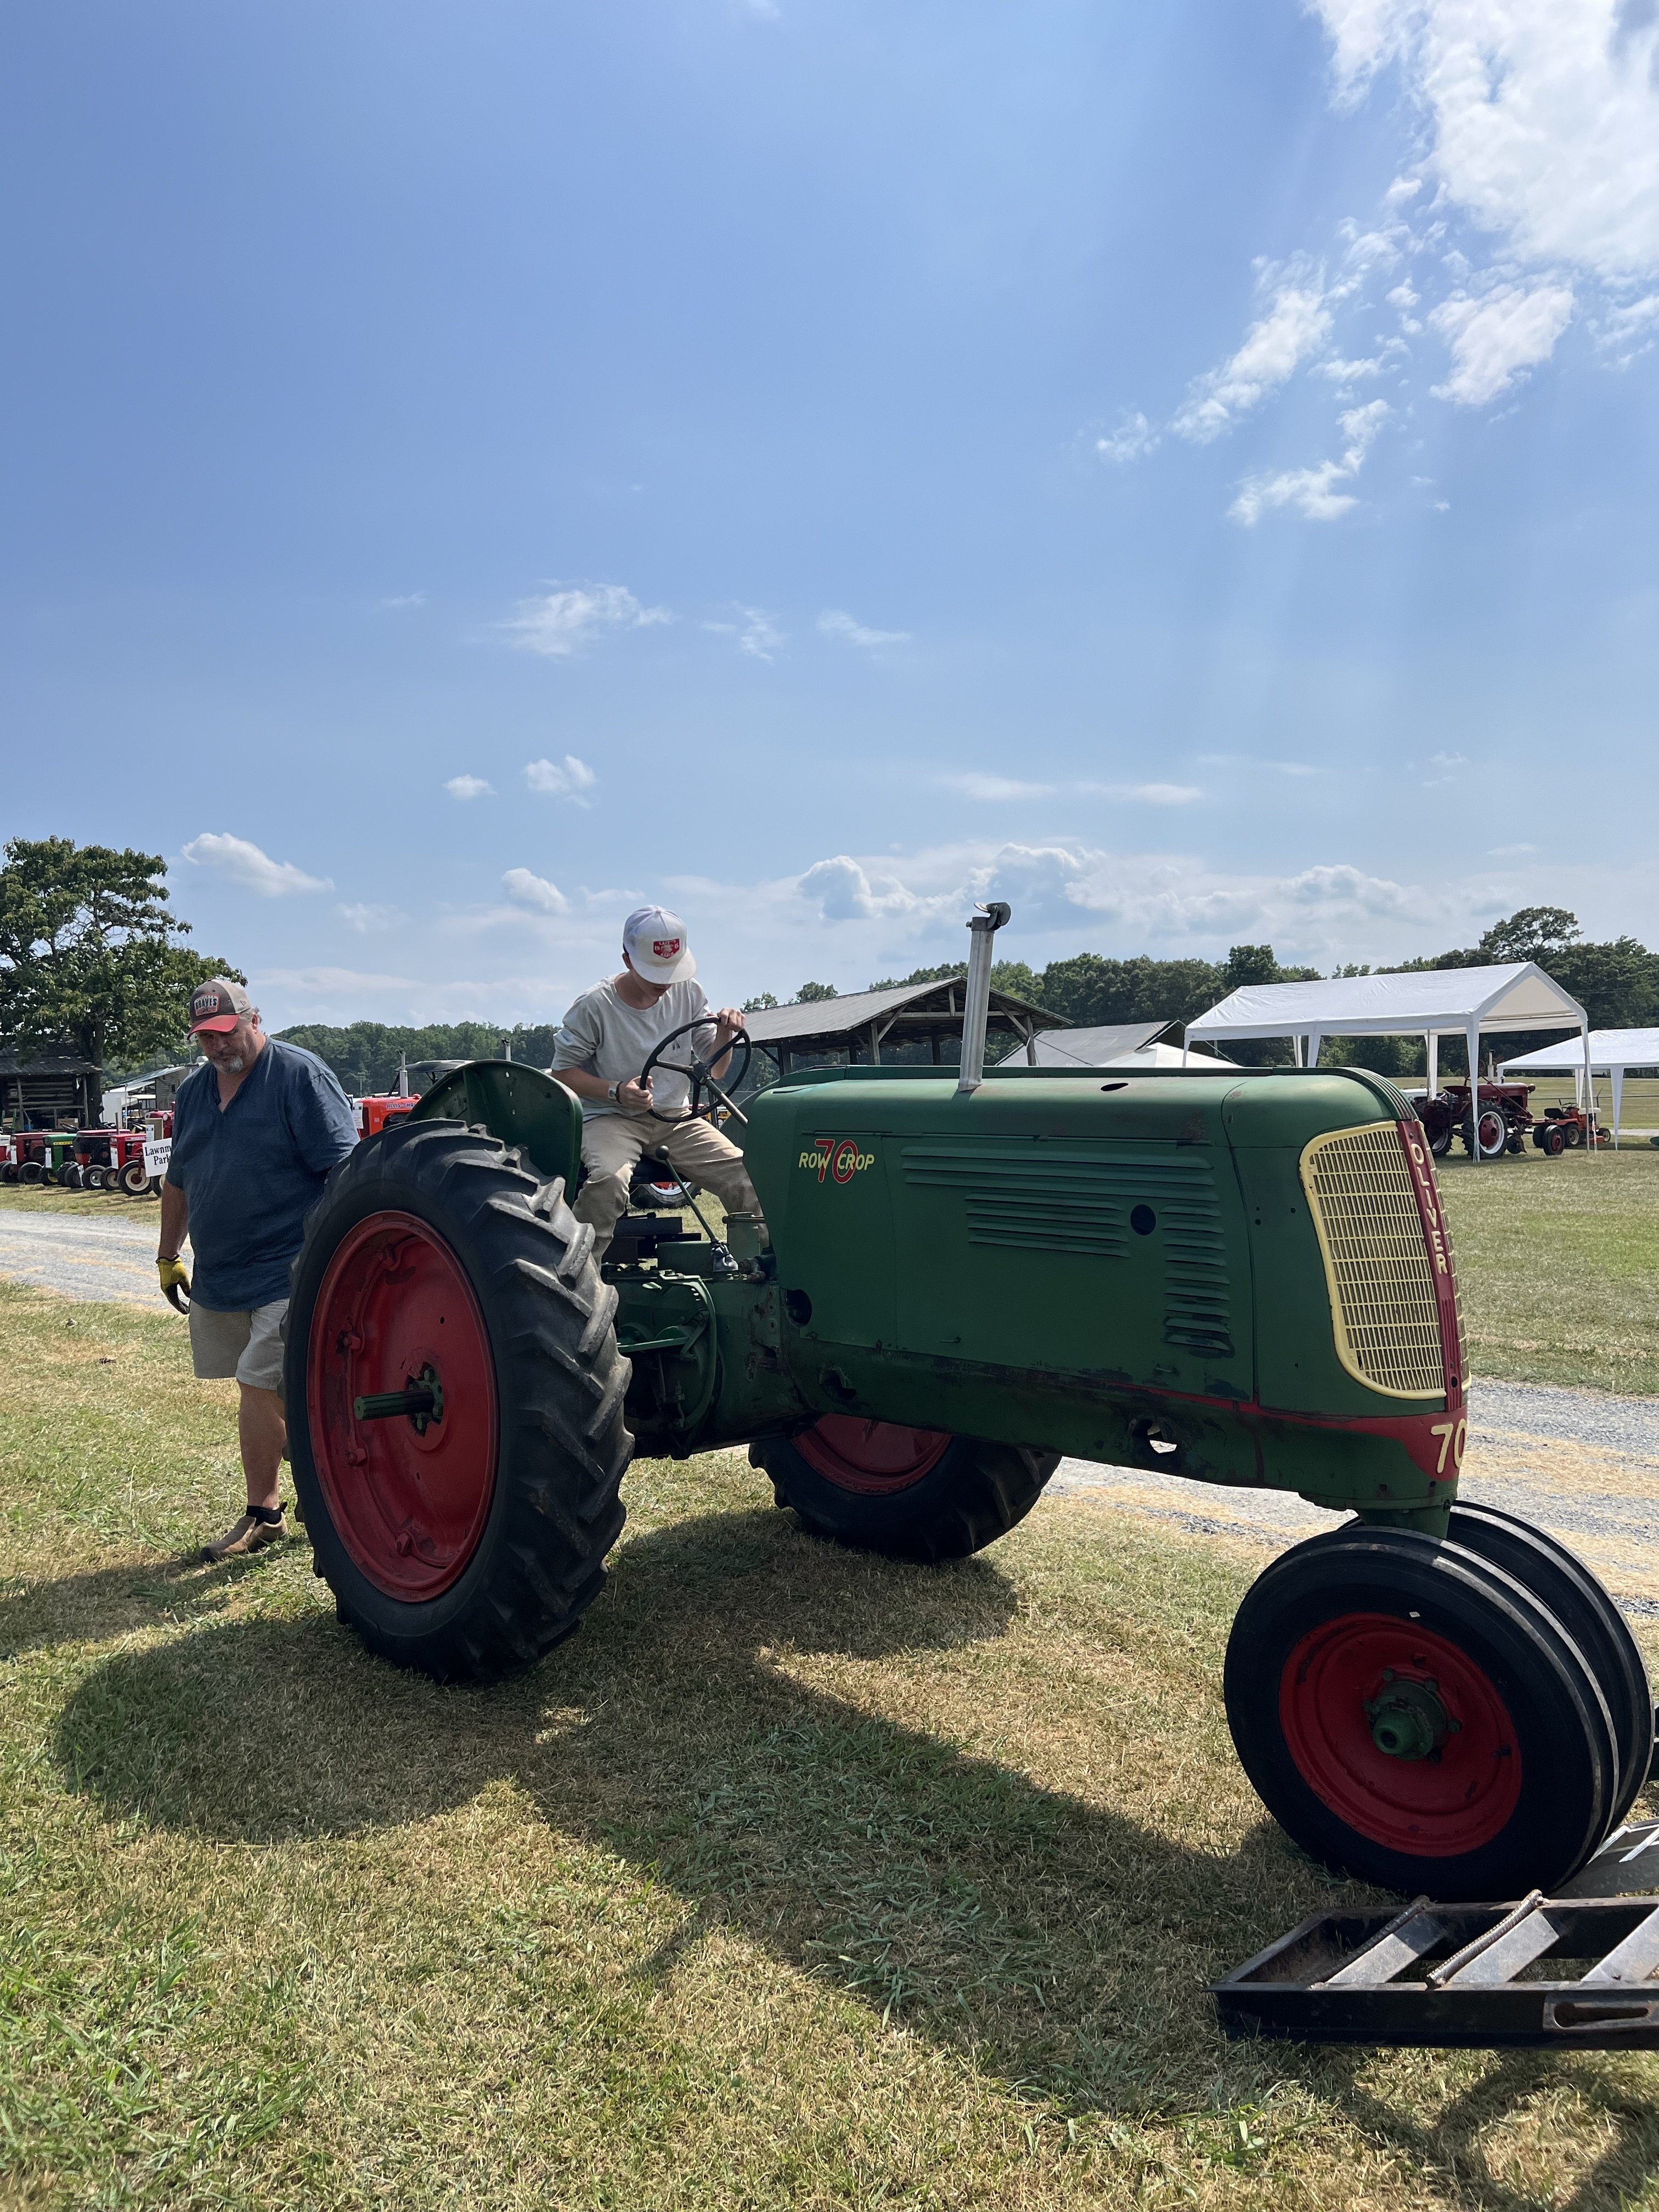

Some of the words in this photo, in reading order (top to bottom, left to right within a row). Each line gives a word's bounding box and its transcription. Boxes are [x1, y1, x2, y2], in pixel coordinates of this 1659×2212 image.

[195, 998, 217, 1010] BRAVES
[798, 1152, 832, 1169] ROW
[837, 1153, 875, 1171] CROP
[815, 1139, 859, 1184] 70
[1411, 1143, 1448, 1274] OLIVER
[1430, 1418, 1467, 1474] 70
